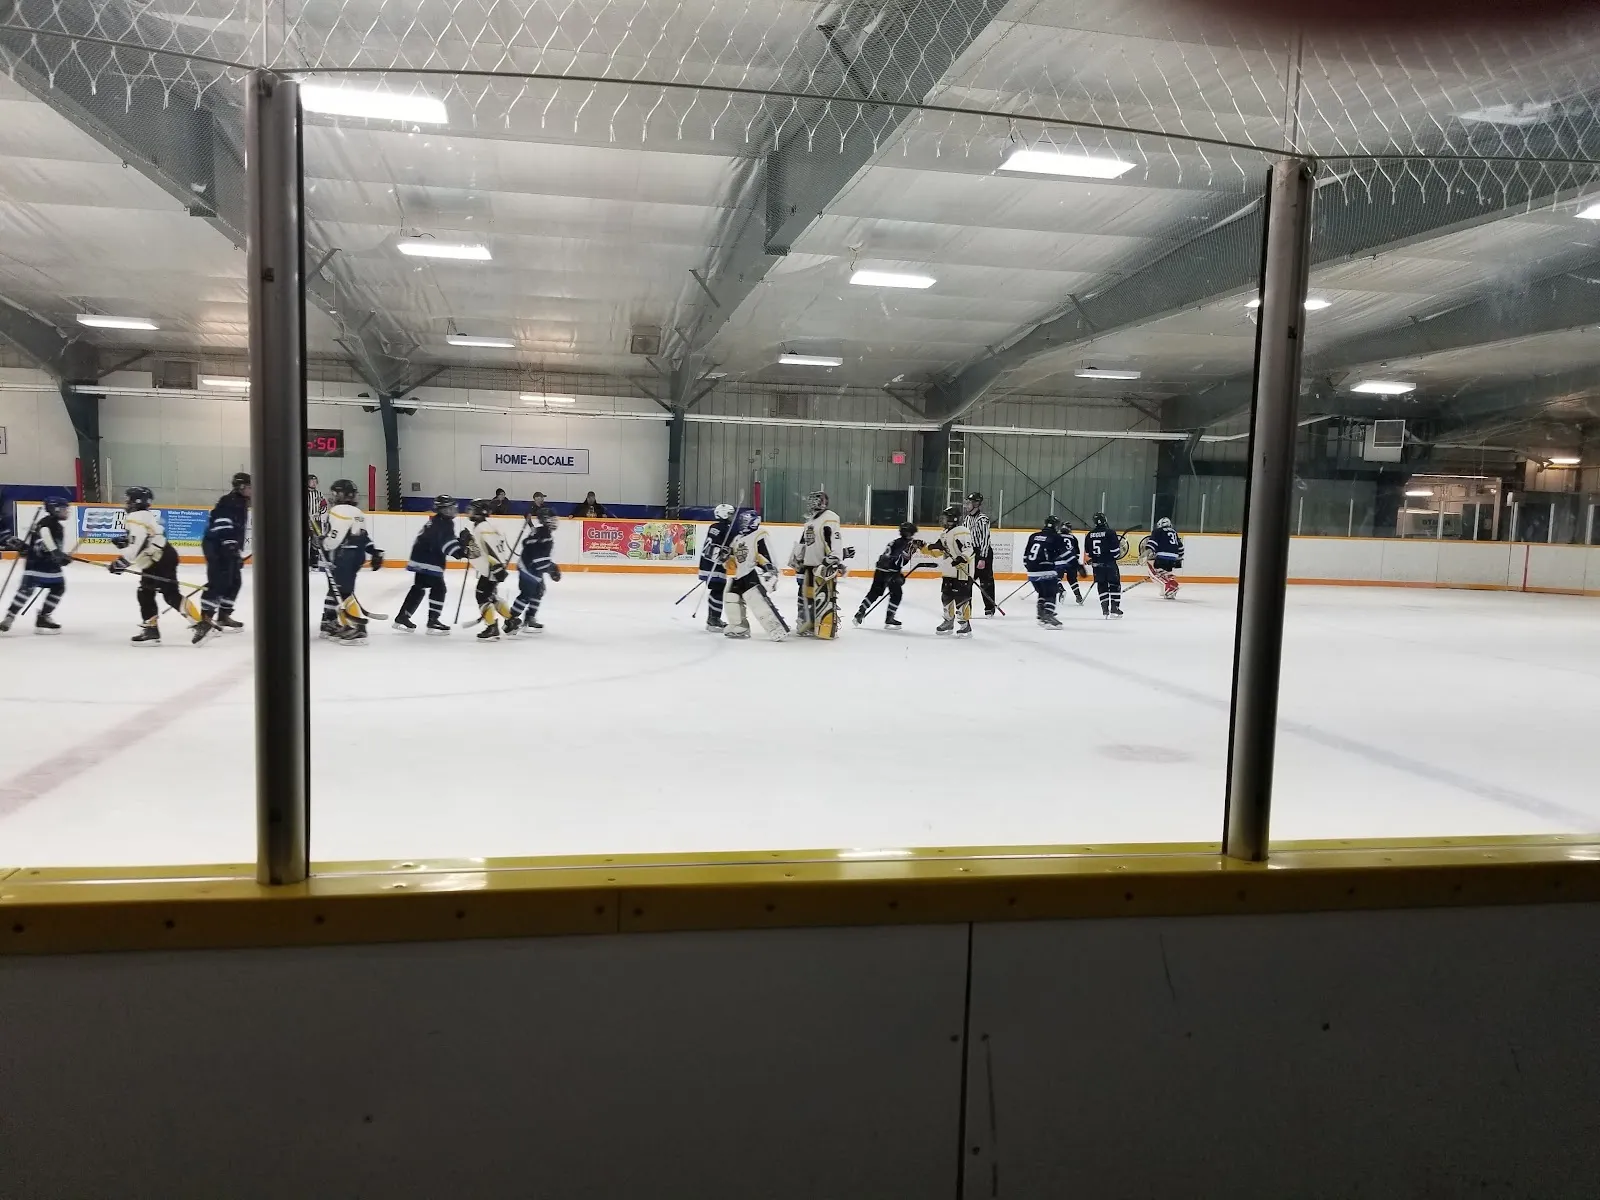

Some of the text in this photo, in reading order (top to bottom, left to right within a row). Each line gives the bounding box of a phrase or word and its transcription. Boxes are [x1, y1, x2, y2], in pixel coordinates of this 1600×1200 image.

[495, 453, 575, 467] HOME-LOCALE
[587, 527, 624, 541] Camps
[1028, 543, 1041, 561] 9
[1092, 540, 1102, 555] 5
